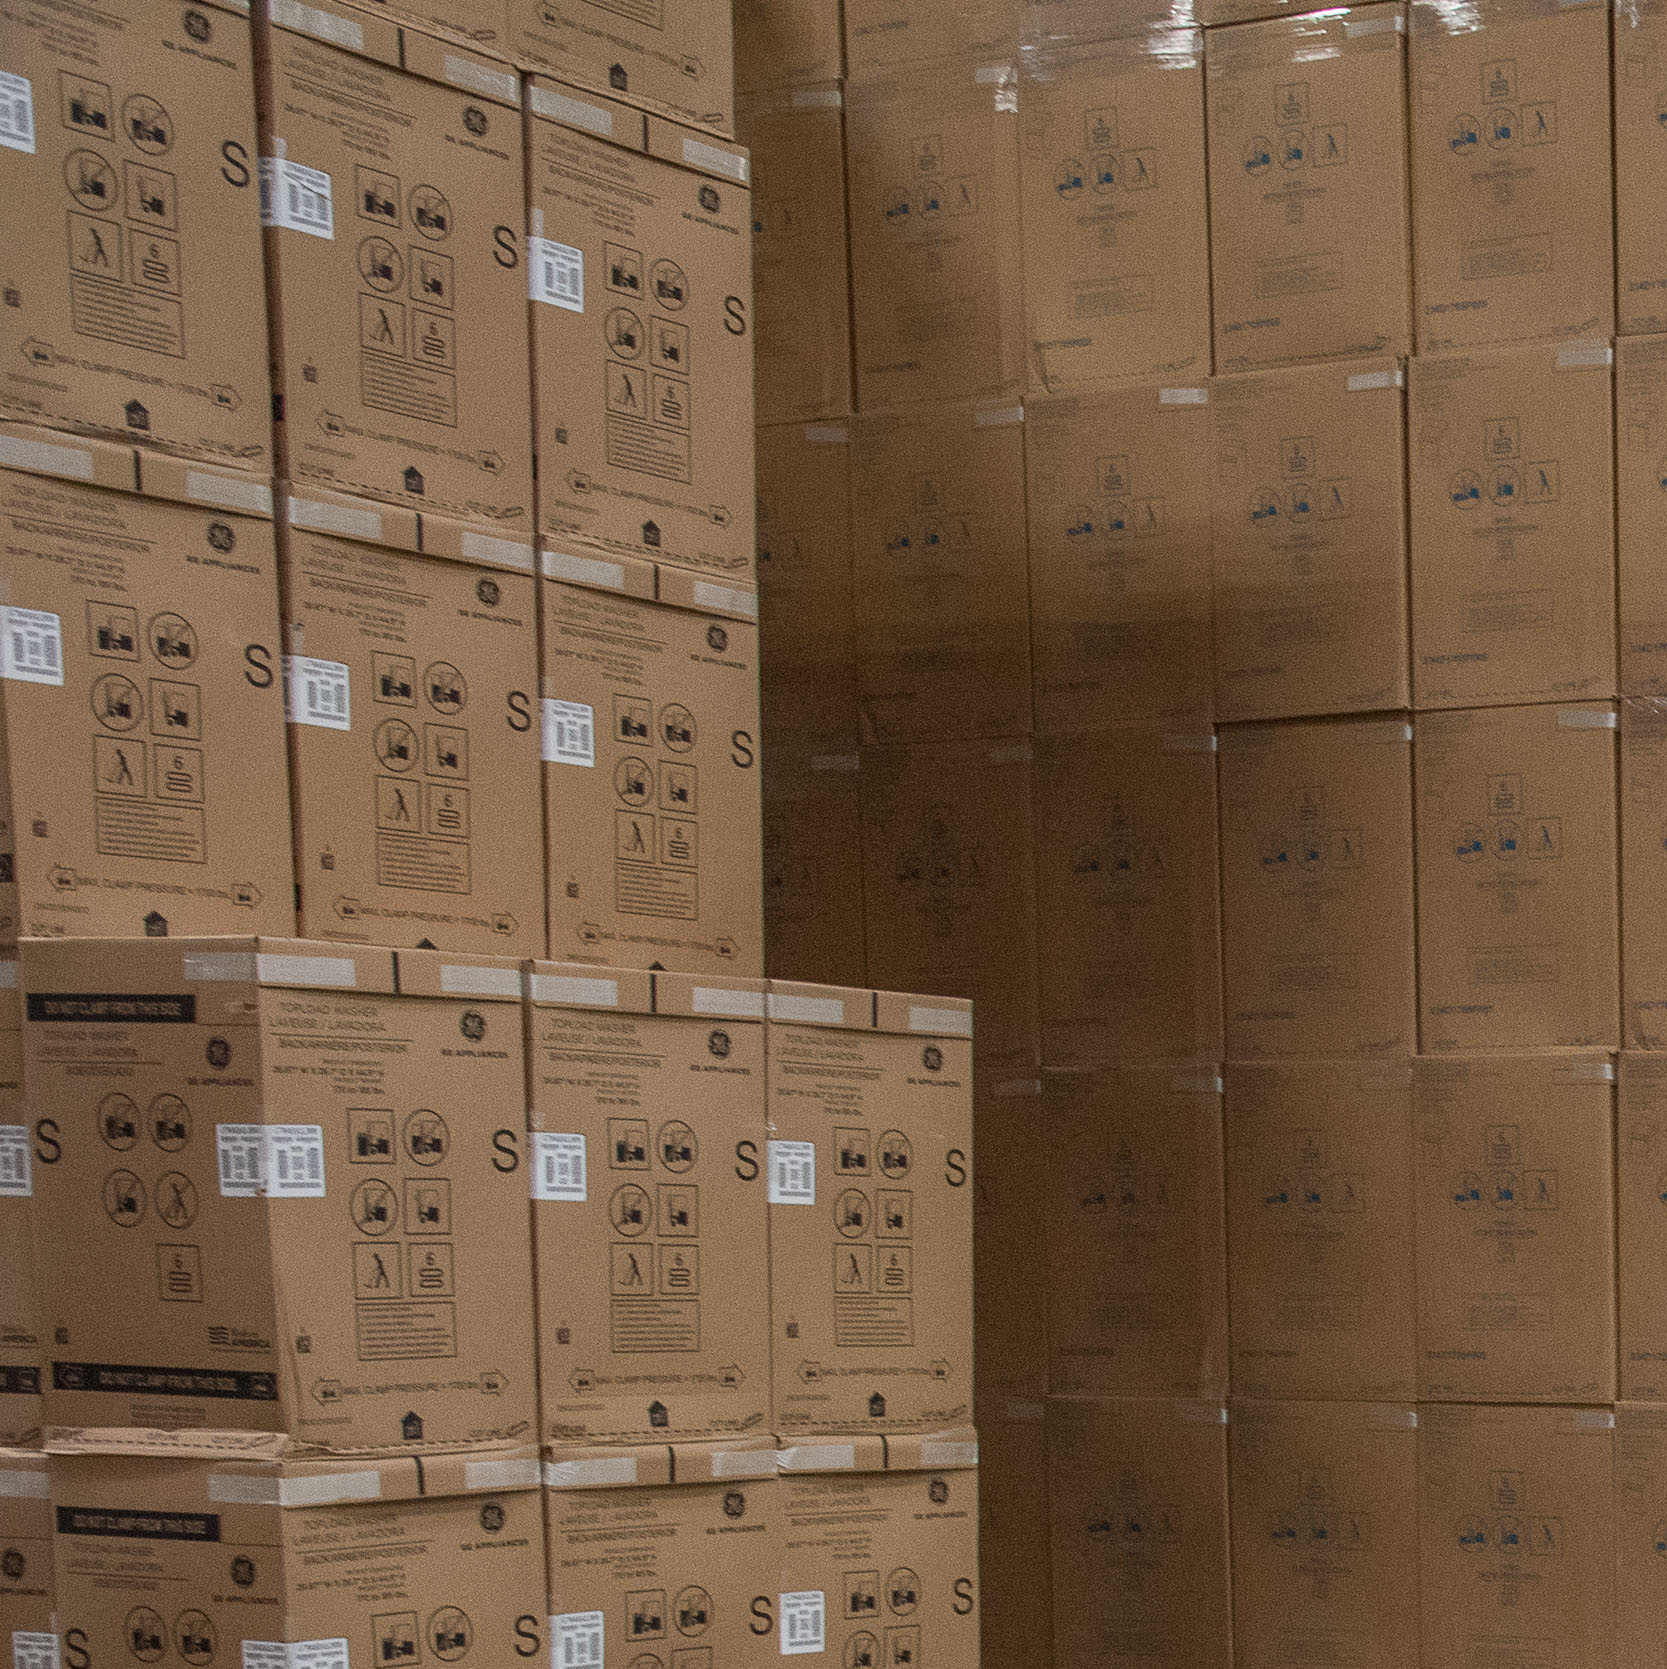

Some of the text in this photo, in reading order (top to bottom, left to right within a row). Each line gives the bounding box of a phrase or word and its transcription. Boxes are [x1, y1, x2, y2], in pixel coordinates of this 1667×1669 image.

[220, 139, 250, 188] S
[492, 225, 519, 270] S
[723, 294, 746, 336] S
[244, 643, 274, 689] S
[506, 690, 532, 733] S
[731, 730, 754, 769] S
[35, 1118, 62, 1164] S
[491, 1128, 519, 1173] S
[735, 1140, 760, 1182] S
[945, 1148, 967, 1187] S
[750, 1594, 774, 1636] S
[952, 1577, 974, 1615] S
[514, 1614, 541, 1658] S
